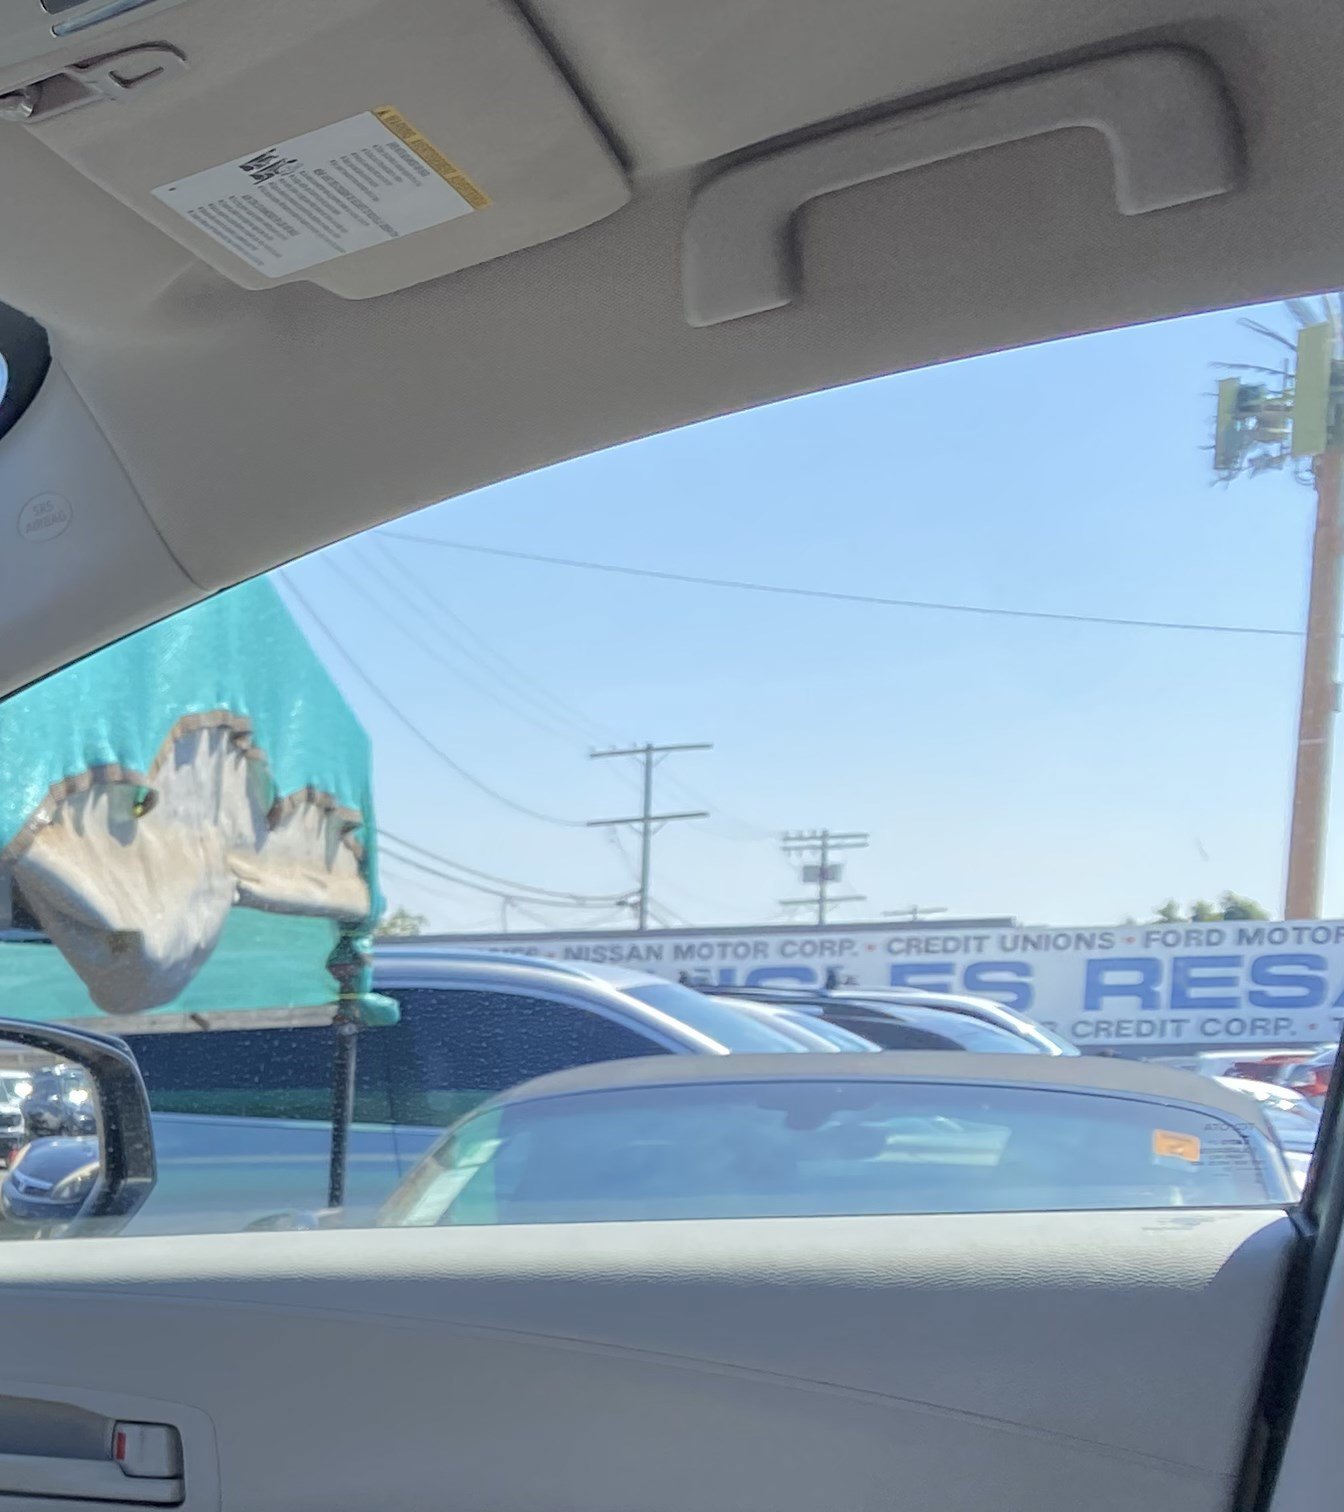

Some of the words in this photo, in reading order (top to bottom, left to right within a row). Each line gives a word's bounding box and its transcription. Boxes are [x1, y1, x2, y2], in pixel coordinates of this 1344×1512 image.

[563, 944, 664, 964] NISSAN
[673, 941, 768, 962] MOTOR
[887, 931, 991, 956] CREDIT
[1000, 930, 1115, 953] UNIONS
[1144, 928, 1226, 949] FORD
[1071, 1017, 1190, 1039] CREDIT
[1199, 1016, 1297, 1038] CORP.
